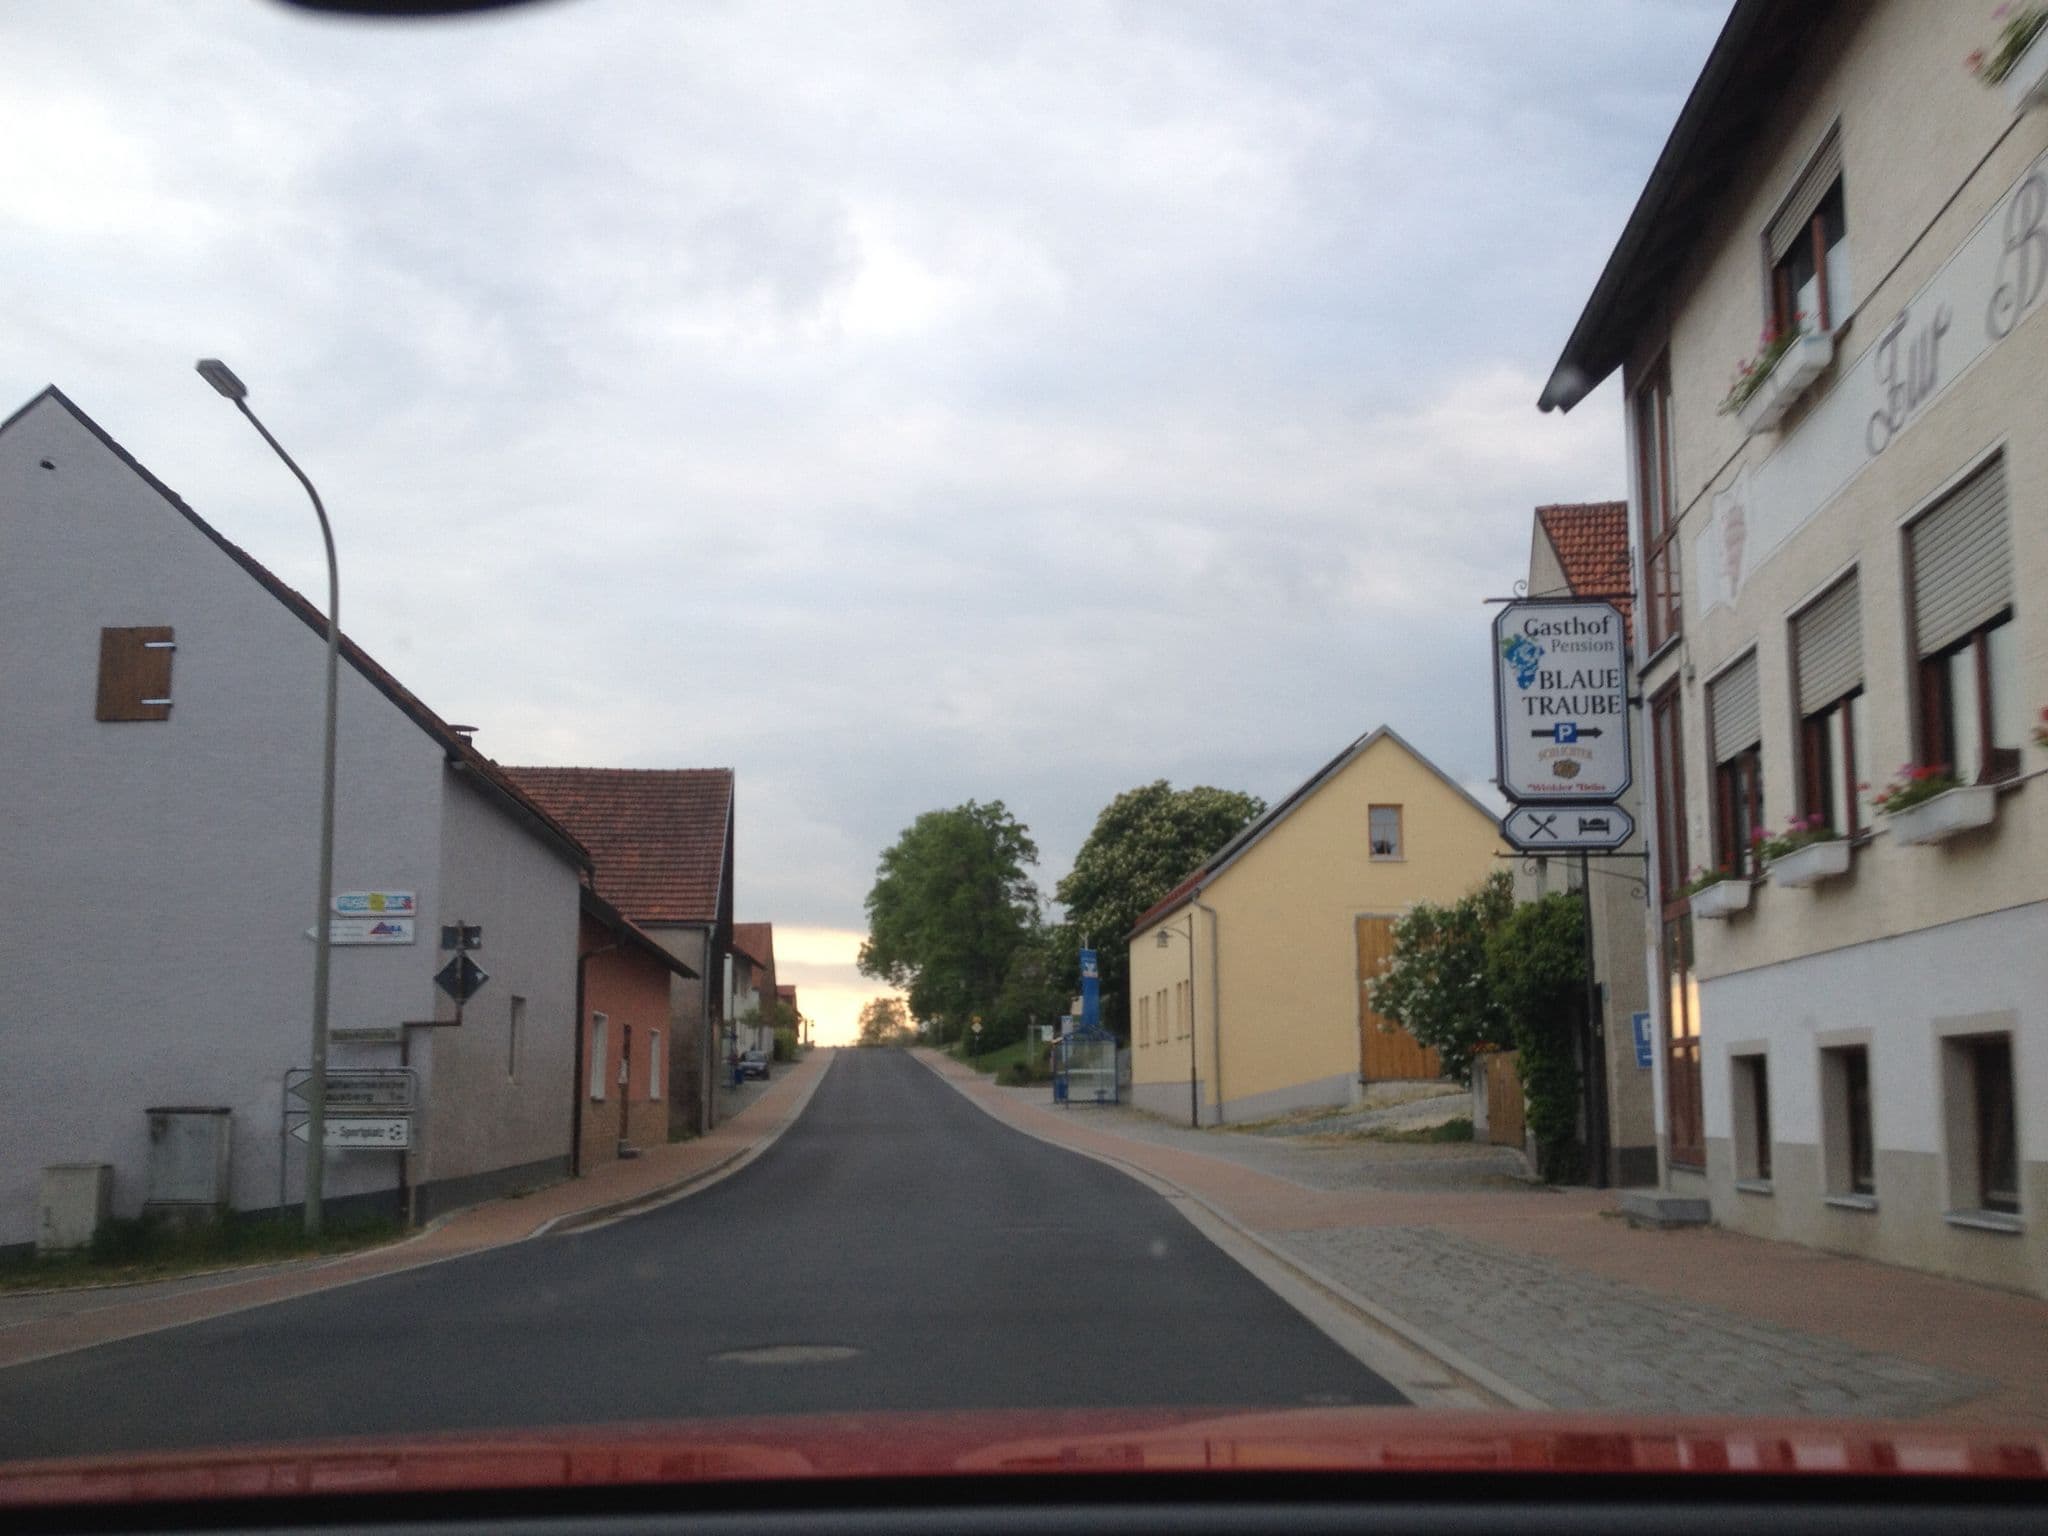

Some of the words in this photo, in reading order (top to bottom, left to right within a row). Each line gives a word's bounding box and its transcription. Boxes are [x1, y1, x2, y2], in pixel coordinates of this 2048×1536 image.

[1524, 616, 1611, 636] Gasthof
[1551, 640, 1613, 653] Pension
[1540, 669, 1619, 689] BLAUE
[1522, 695, 1620, 715] TRAUBE
[1559, 725, 1573, 741] P
